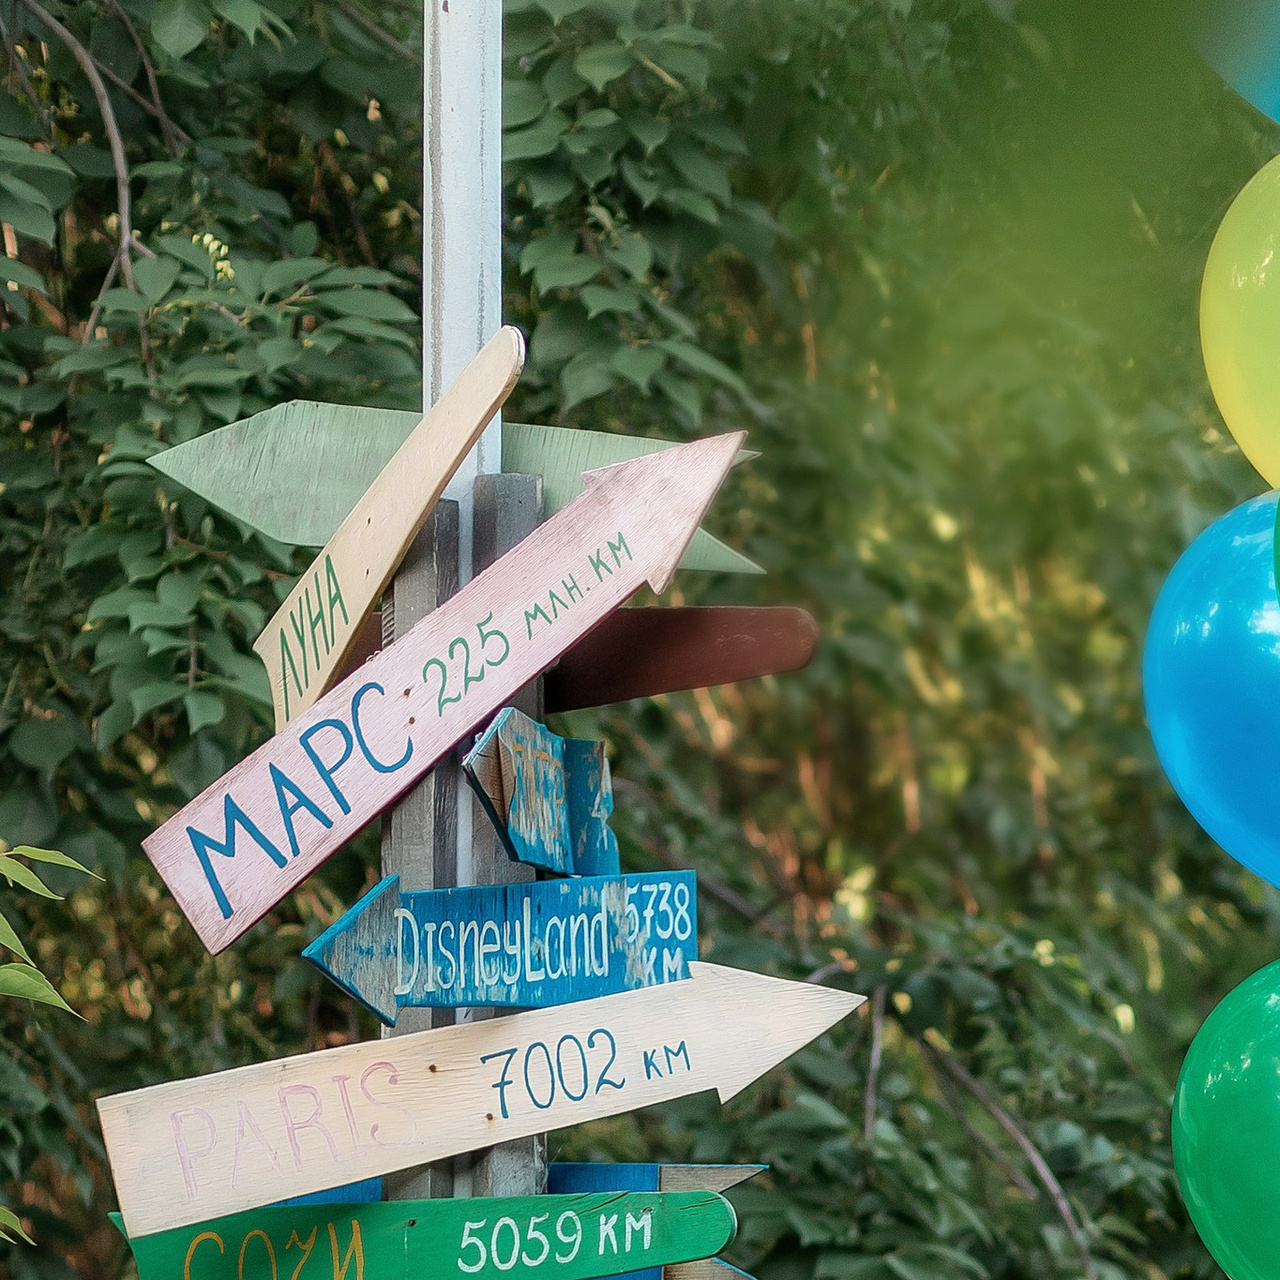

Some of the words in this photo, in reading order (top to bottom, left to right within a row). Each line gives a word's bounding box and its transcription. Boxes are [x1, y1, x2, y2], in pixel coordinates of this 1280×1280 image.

[282, 553, 349, 722] ЛУНА
[186, 681, 414, 919] МАРС
[422, 611, 510, 717] 225
[624, 882, 692, 943] 5738
[171, 1061, 417, 1199] PARIS
[480, 1028, 625, 1119] 7002
[457, 1210, 582, 1273] 5059
